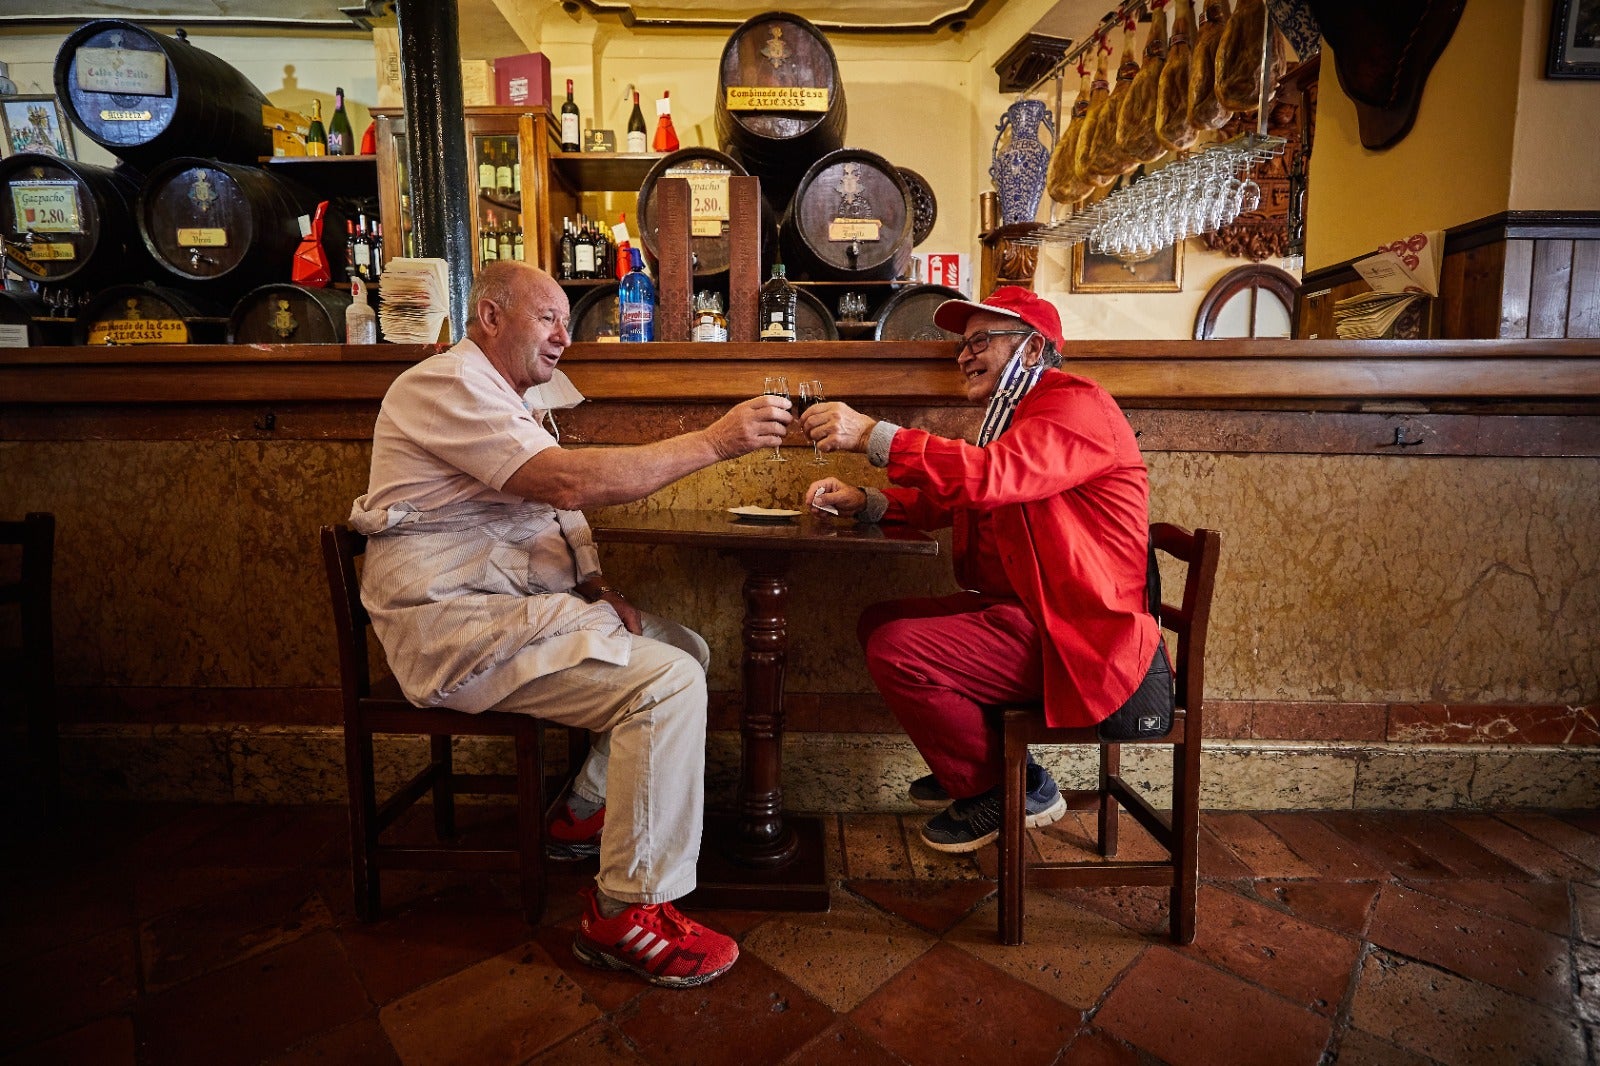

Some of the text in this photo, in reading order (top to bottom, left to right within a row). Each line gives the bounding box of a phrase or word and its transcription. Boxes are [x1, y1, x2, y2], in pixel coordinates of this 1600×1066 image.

[730, 89, 823, 98] Combinado de la Casa
[134, 322, 143, 330] de
[146, 320, 154, 330] la
[156, 320, 181, 330] Casa
